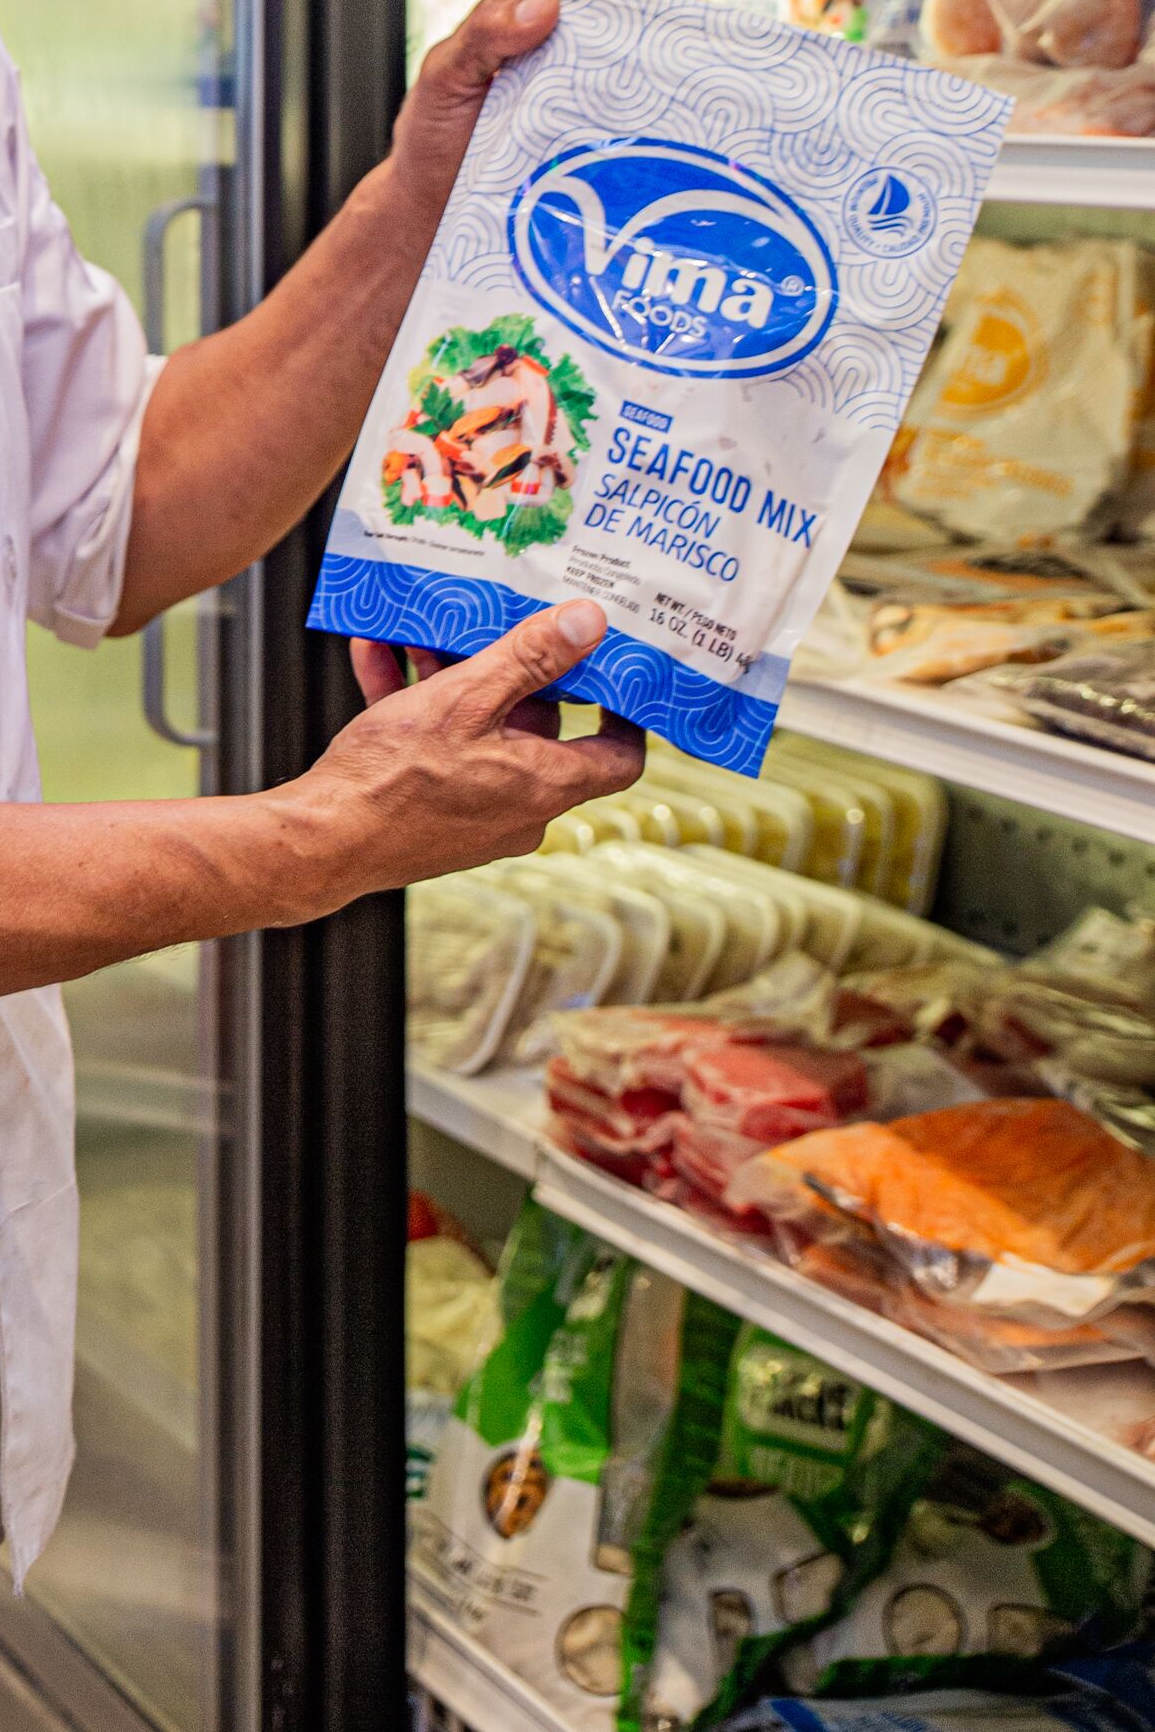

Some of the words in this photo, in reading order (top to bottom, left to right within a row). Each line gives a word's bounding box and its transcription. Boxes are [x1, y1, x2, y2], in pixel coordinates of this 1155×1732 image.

[522, 174, 776, 330] Vima
[613, 289, 707, 339] FOODS
[593, 473, 722, 539] SALPICÓN
[607, 426, 752, 514] SEAFOOD
[756, 489, 817, 549] MIX
[583, 502, 625, 534] DE
[626, 515, 740, 582] MARISCO
[650, 607, 666, 626] 16
[691, 628, 704, 648] (1
[708, 637, 734, 662] LB)
[654, 592, 672, 606] NET
[691, 611, 715, 631] PESO
[715, 621, 738, 642] NETO
